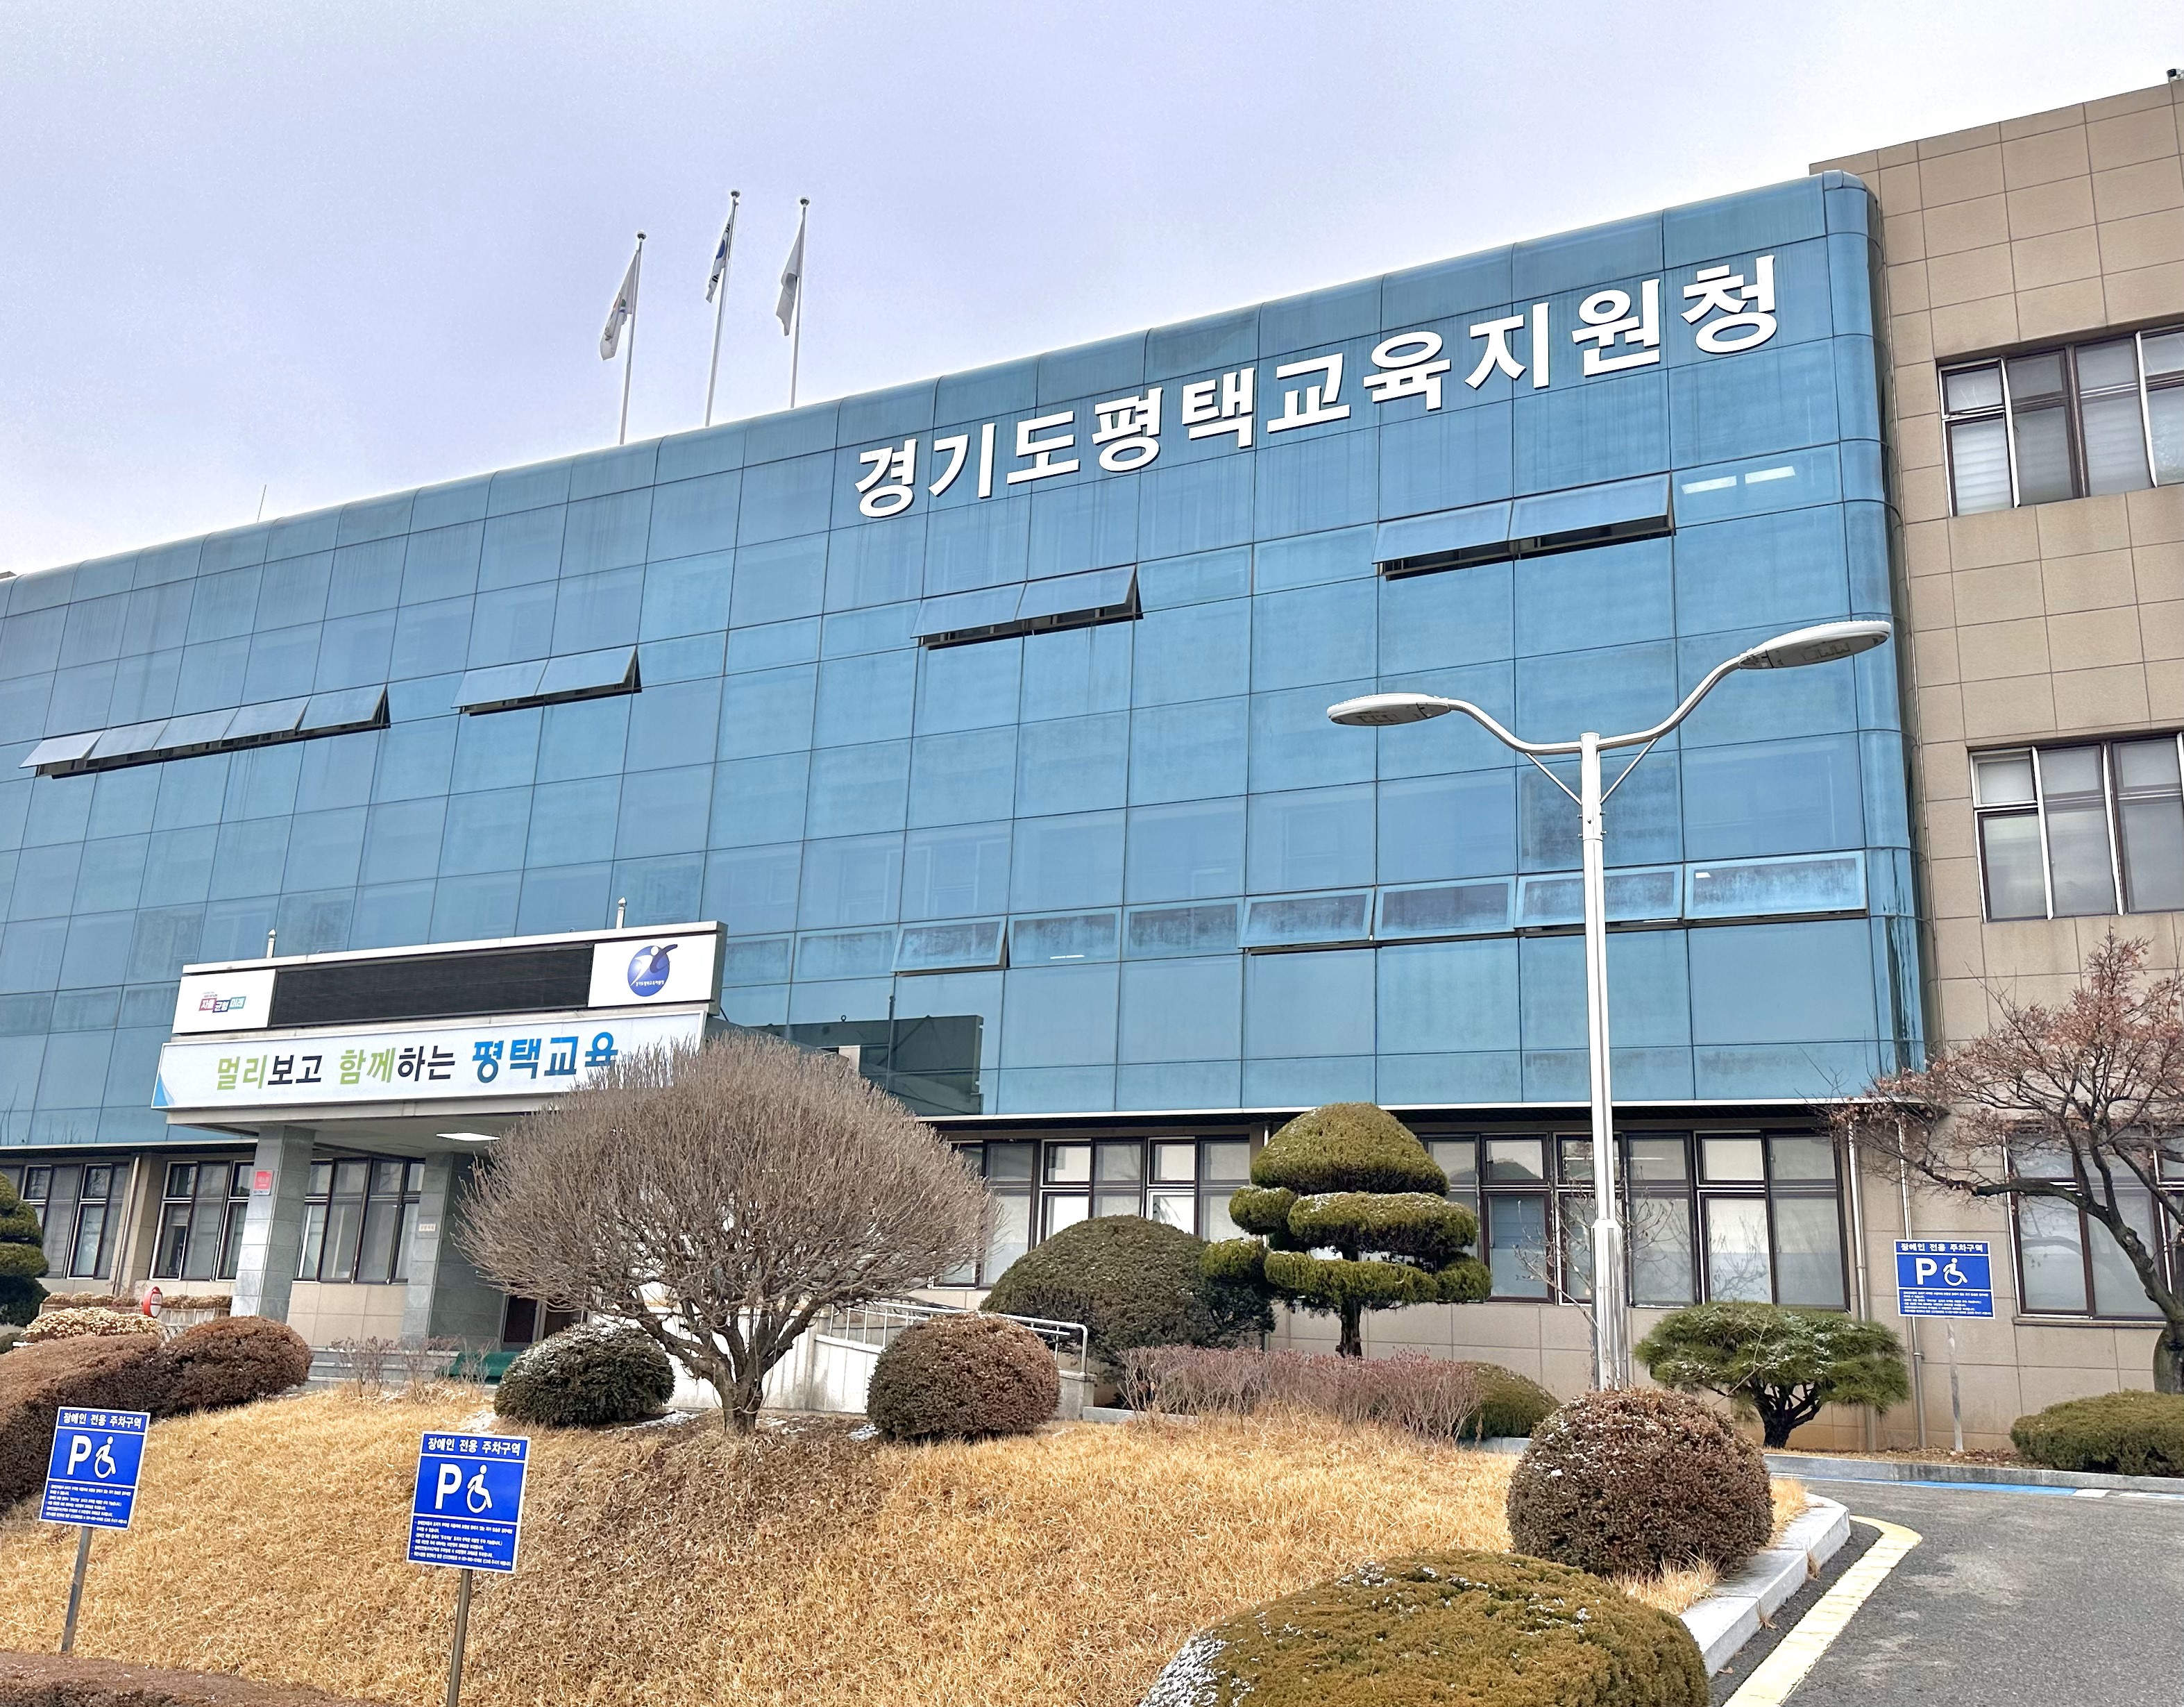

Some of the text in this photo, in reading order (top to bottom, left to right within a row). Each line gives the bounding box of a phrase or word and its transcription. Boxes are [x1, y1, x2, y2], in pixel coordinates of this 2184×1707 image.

[854, 254, 1778, 518] 경기도평택교육지원청
[217, 1054, 323, 1091] 멀리보고
[339, 1045, 455, 1084] 함께하는
[1901, 1243, 1983, 1253] 장애인 전용 주차구역
[1915, 1257, 1938, 1285] P
[63, 1412, 142, 1429] 장애인 전용 주차구역
[67, 1434, 92, 1475] P
[428, 1437, 521, 1456] 장애인 전용 주차구역
[434, 1463, 462, 1509] P
